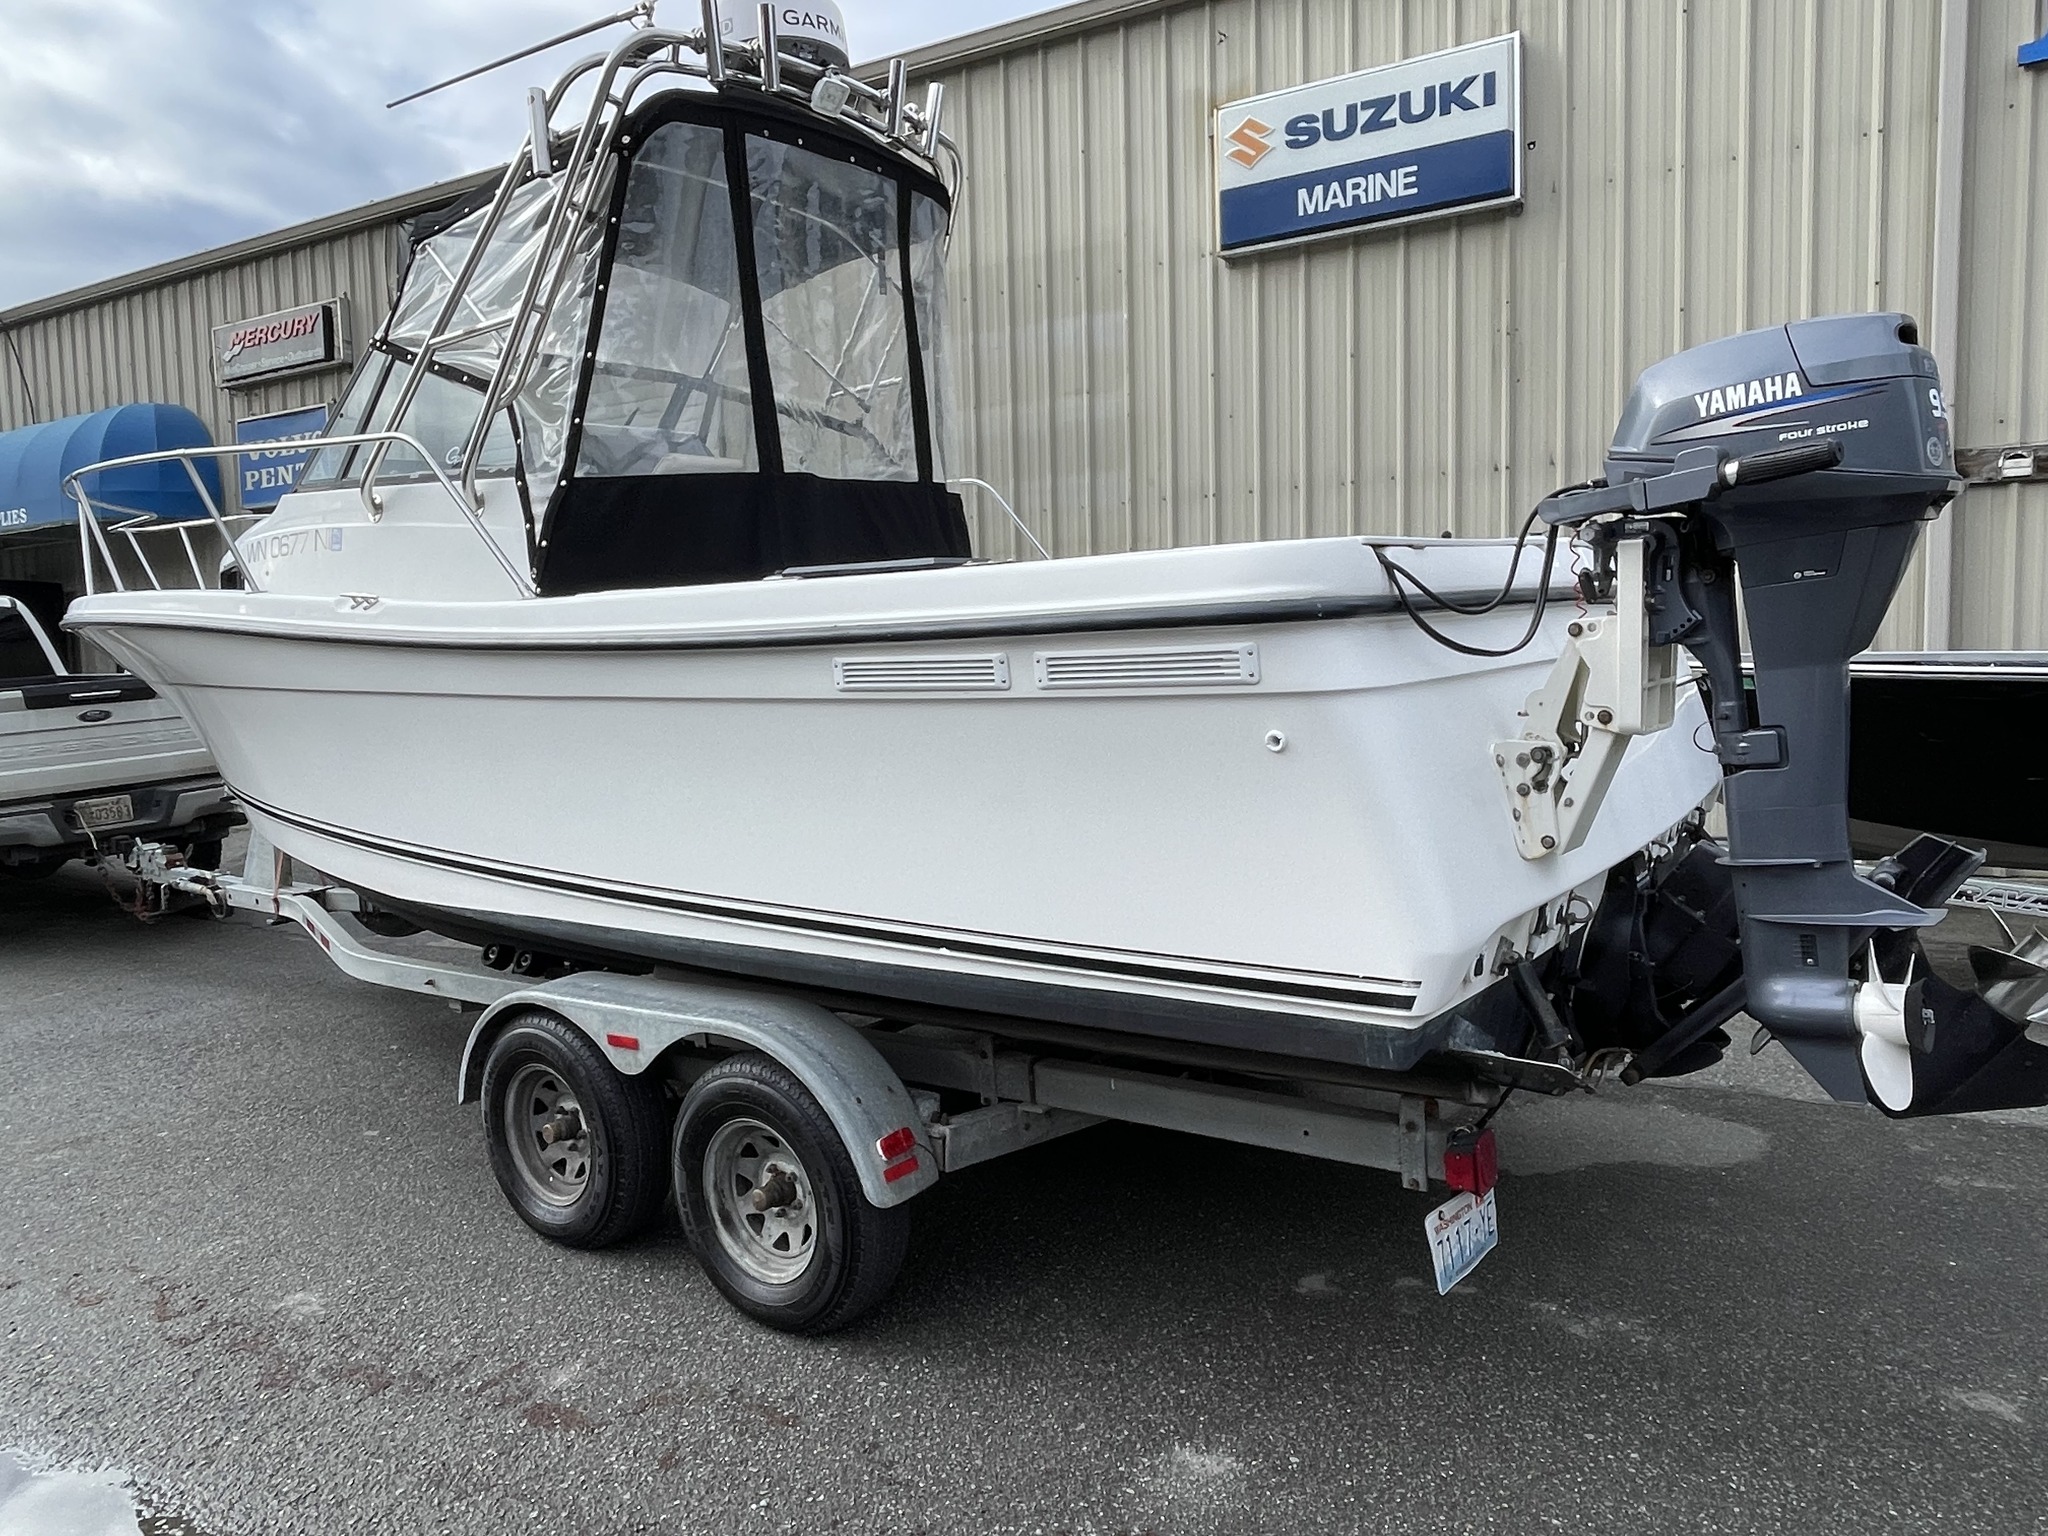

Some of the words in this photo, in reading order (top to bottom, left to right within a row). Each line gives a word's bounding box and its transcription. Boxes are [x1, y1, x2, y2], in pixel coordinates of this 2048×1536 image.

[1284, 70, 1496, 150] SUZUKI
[1297, 165, 1419, 216] MARINE
[227, 312, 320, 352] MERCURY
[1694, 372, 1803, 418] YAMAHA
[270, 531, 309, 558] 0677
[1433, 1202, 1473, 1235] WASHINGTON
